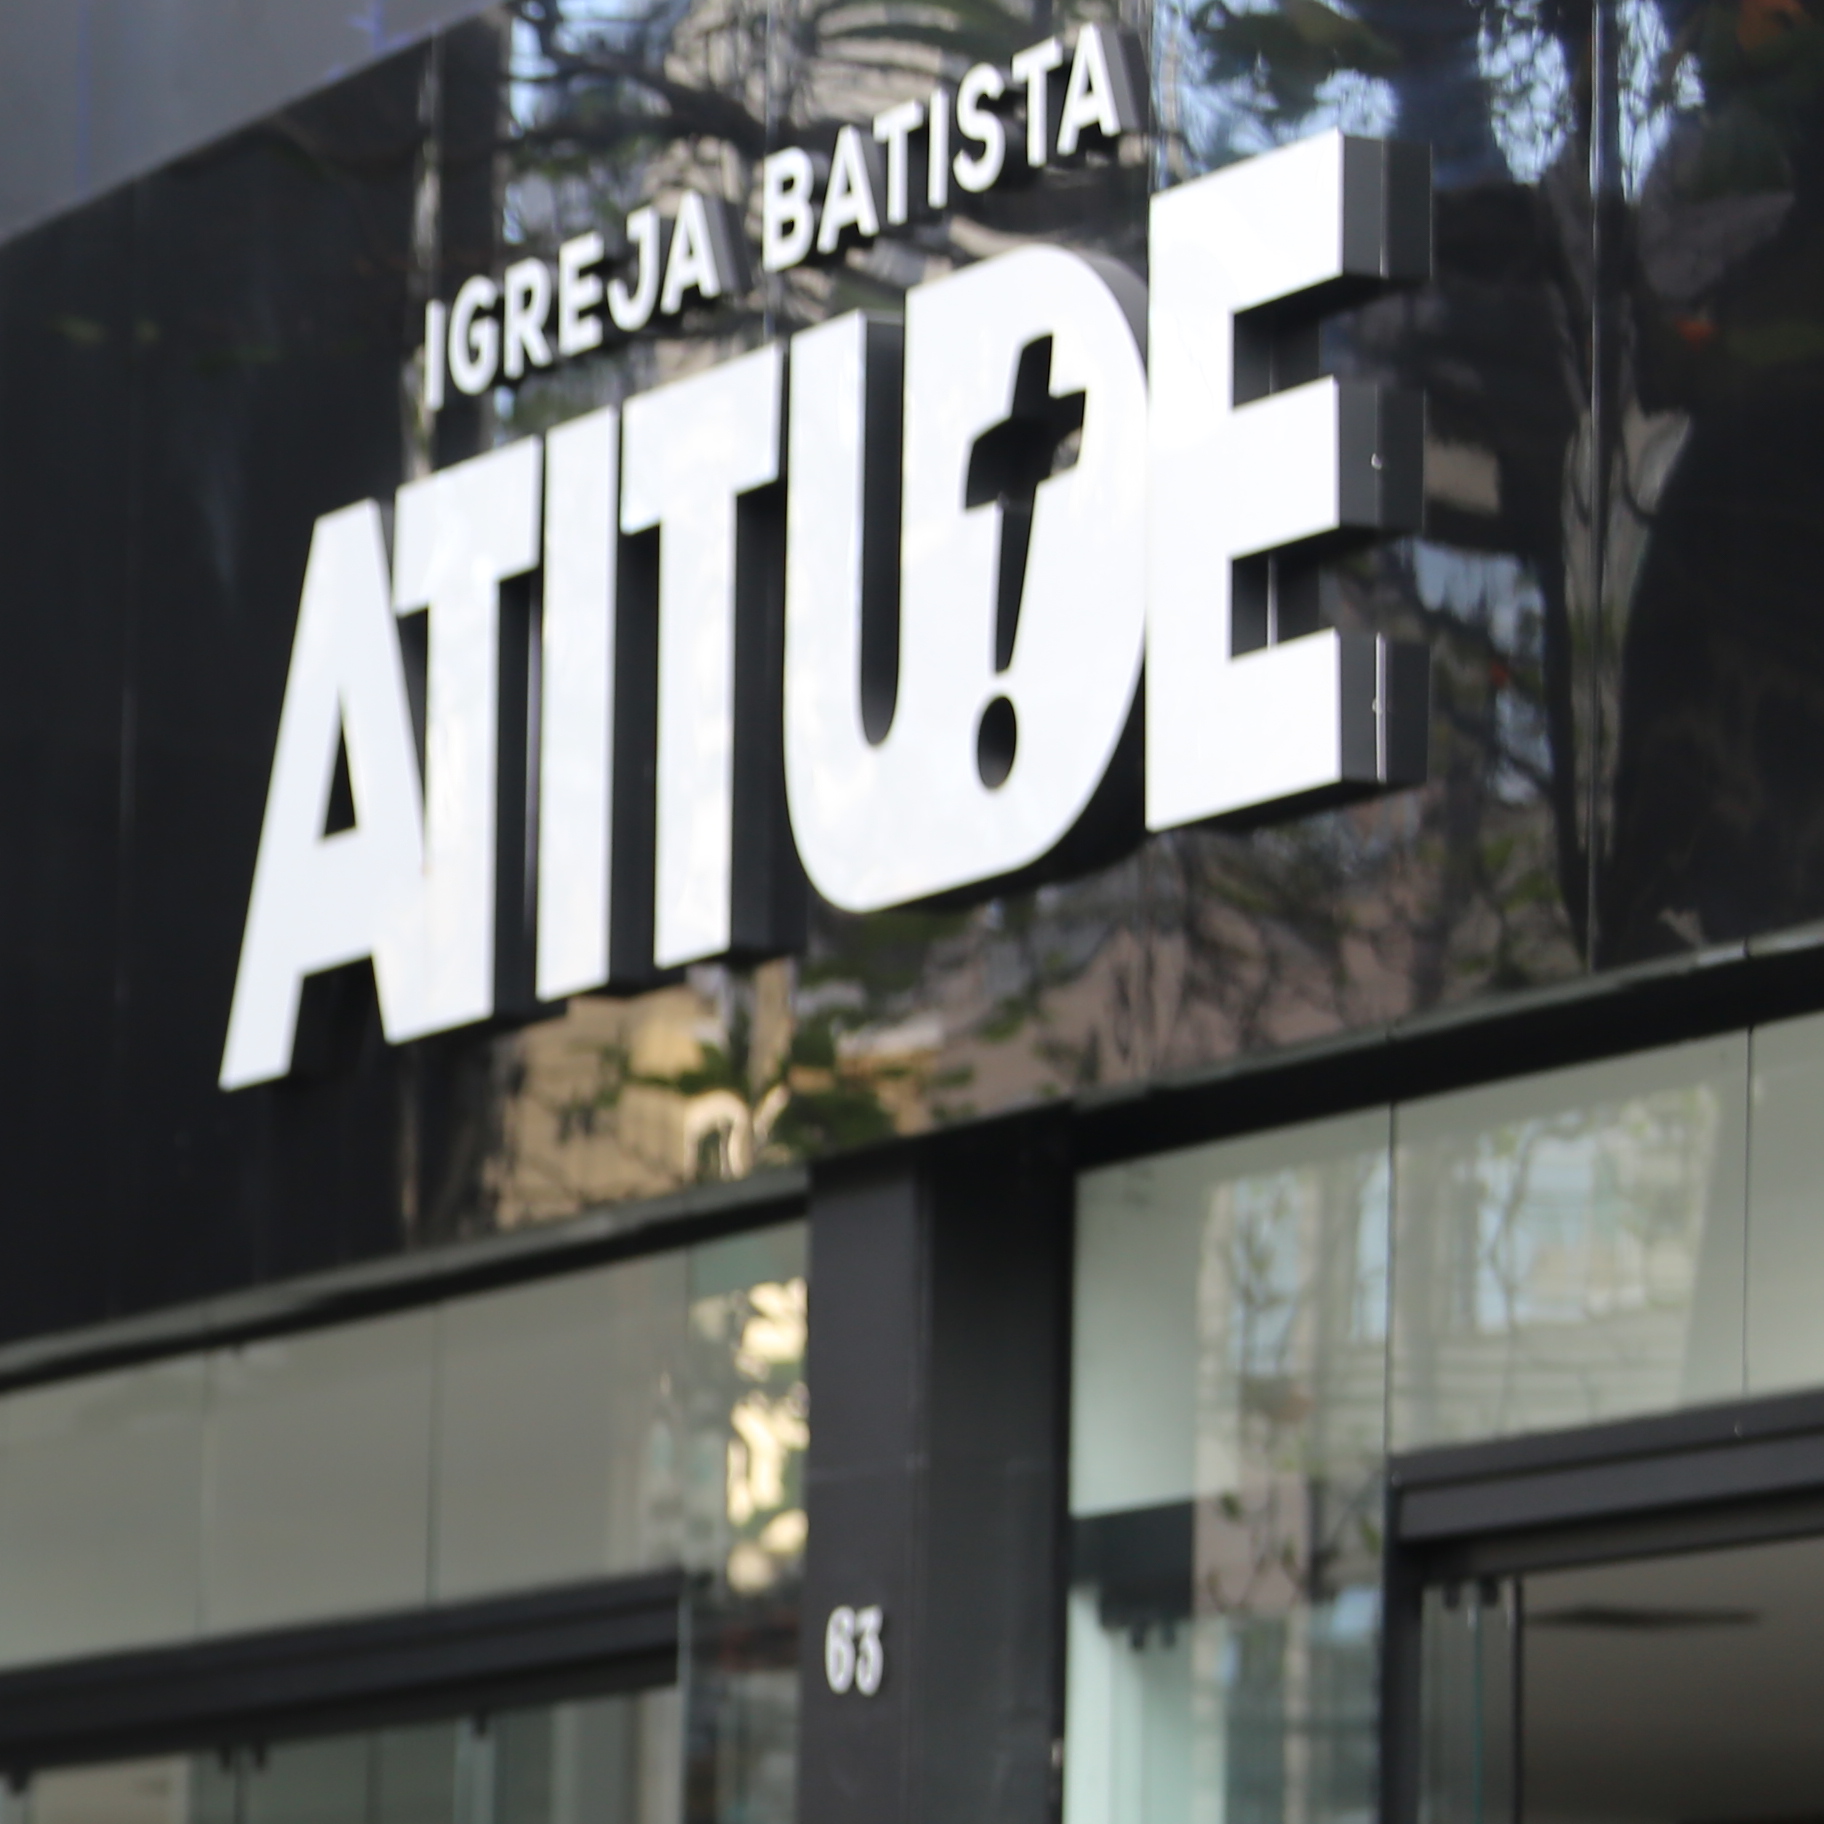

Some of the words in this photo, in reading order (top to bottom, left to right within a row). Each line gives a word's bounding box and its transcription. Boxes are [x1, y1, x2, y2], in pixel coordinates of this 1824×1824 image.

[423, 189, 722, 411] IGREJA
[761, 22, 1122, 272] BATISTA
[218, 128, 1344, 1091] ATITUDE
[825, 1605, 883, 1695] 63
